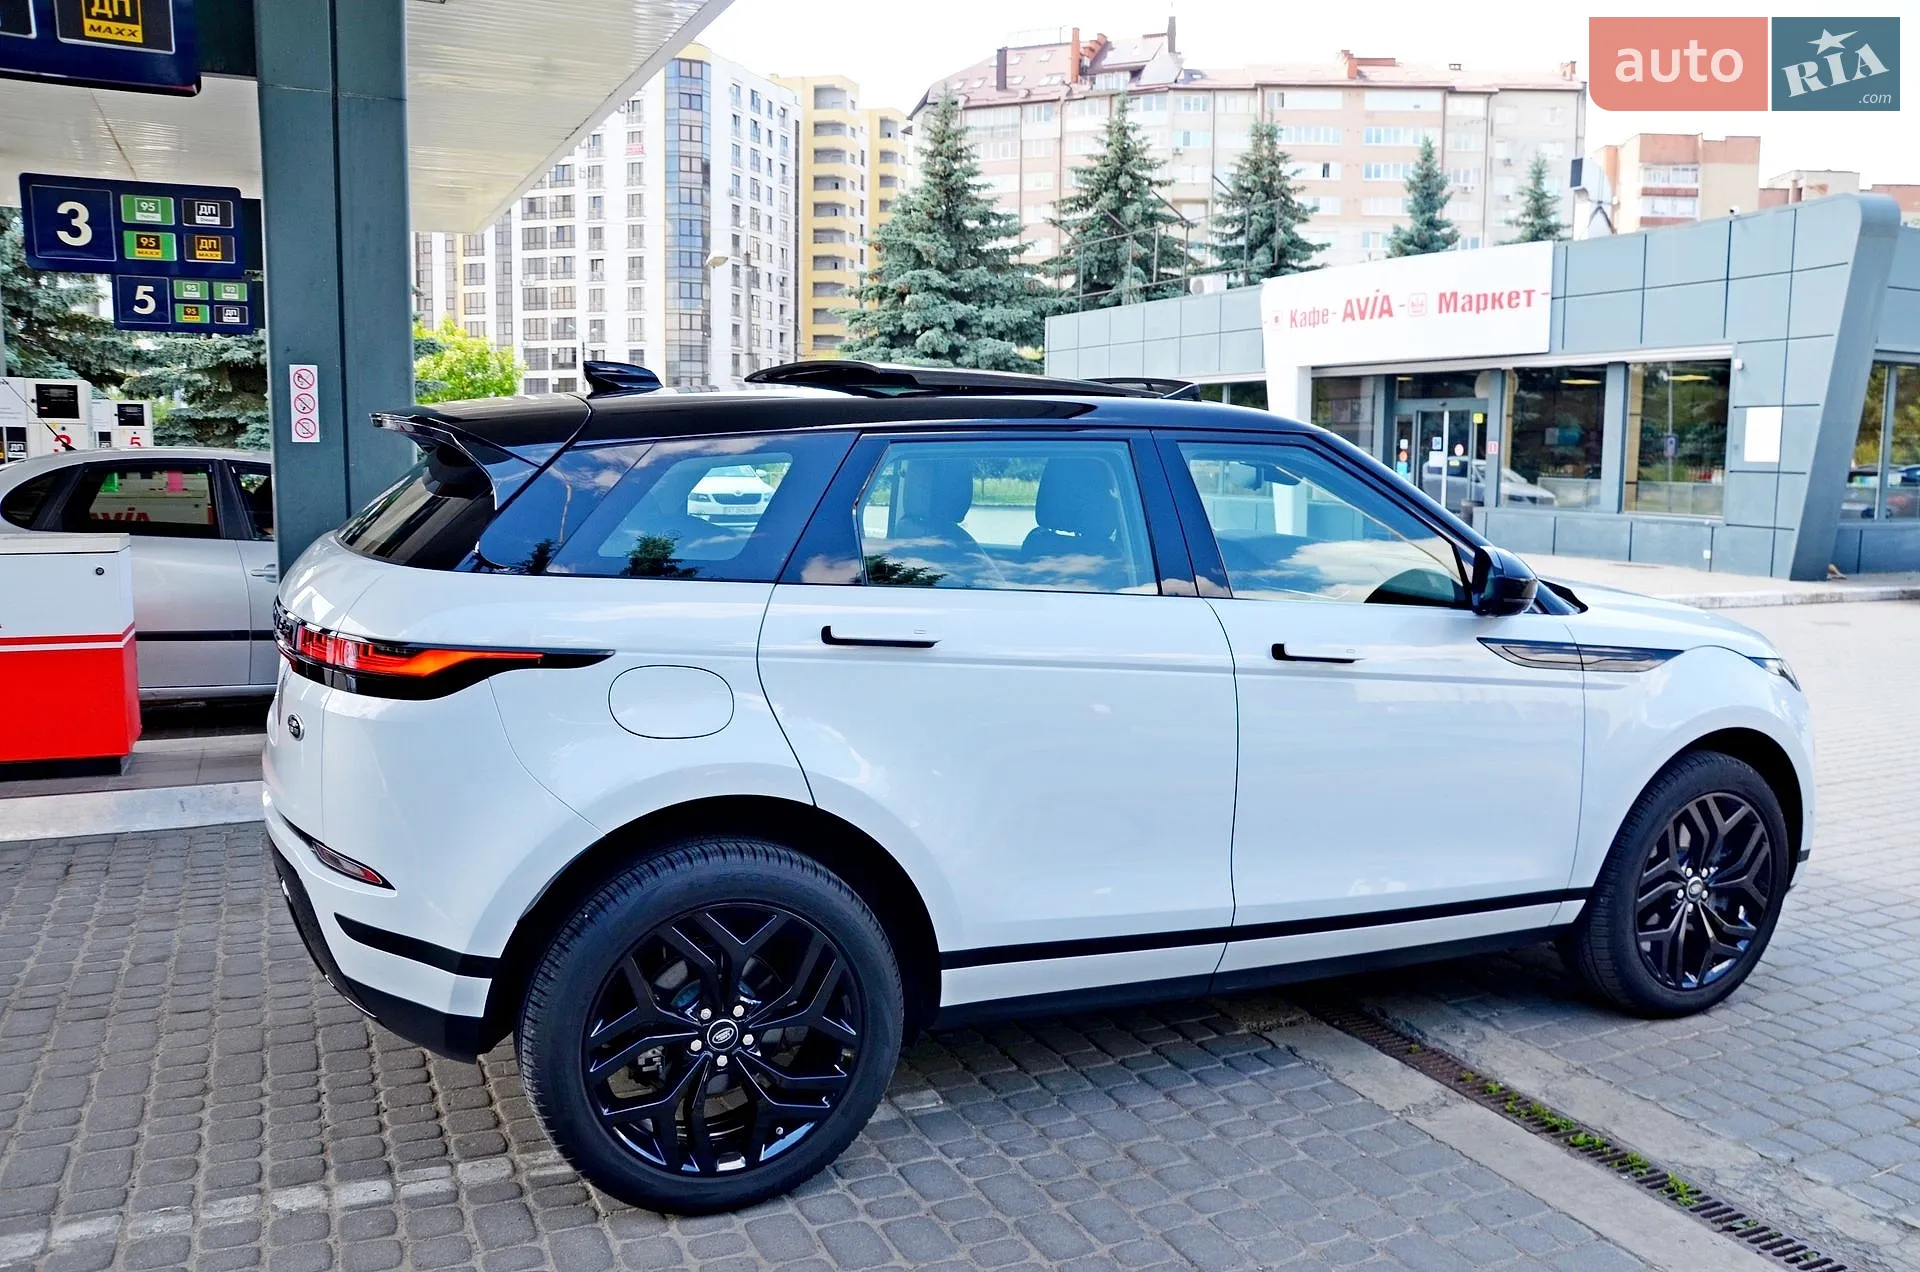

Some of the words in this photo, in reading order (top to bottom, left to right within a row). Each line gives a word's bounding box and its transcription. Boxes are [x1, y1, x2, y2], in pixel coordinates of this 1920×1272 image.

[88, 24, 138, 38] MAXX
[140, 201, 156, 212] 95
[198, 204, 217, 216] ДП
[56, 201, 93, 246] 3
[140, 237, 156, 248] 95
[199, 239, 218, 250] ДП
[132, 285, 156, 315] 5
[1289, 306, 1329, 329] Кафе
[1438, 288, 1536, 315] Маркет
